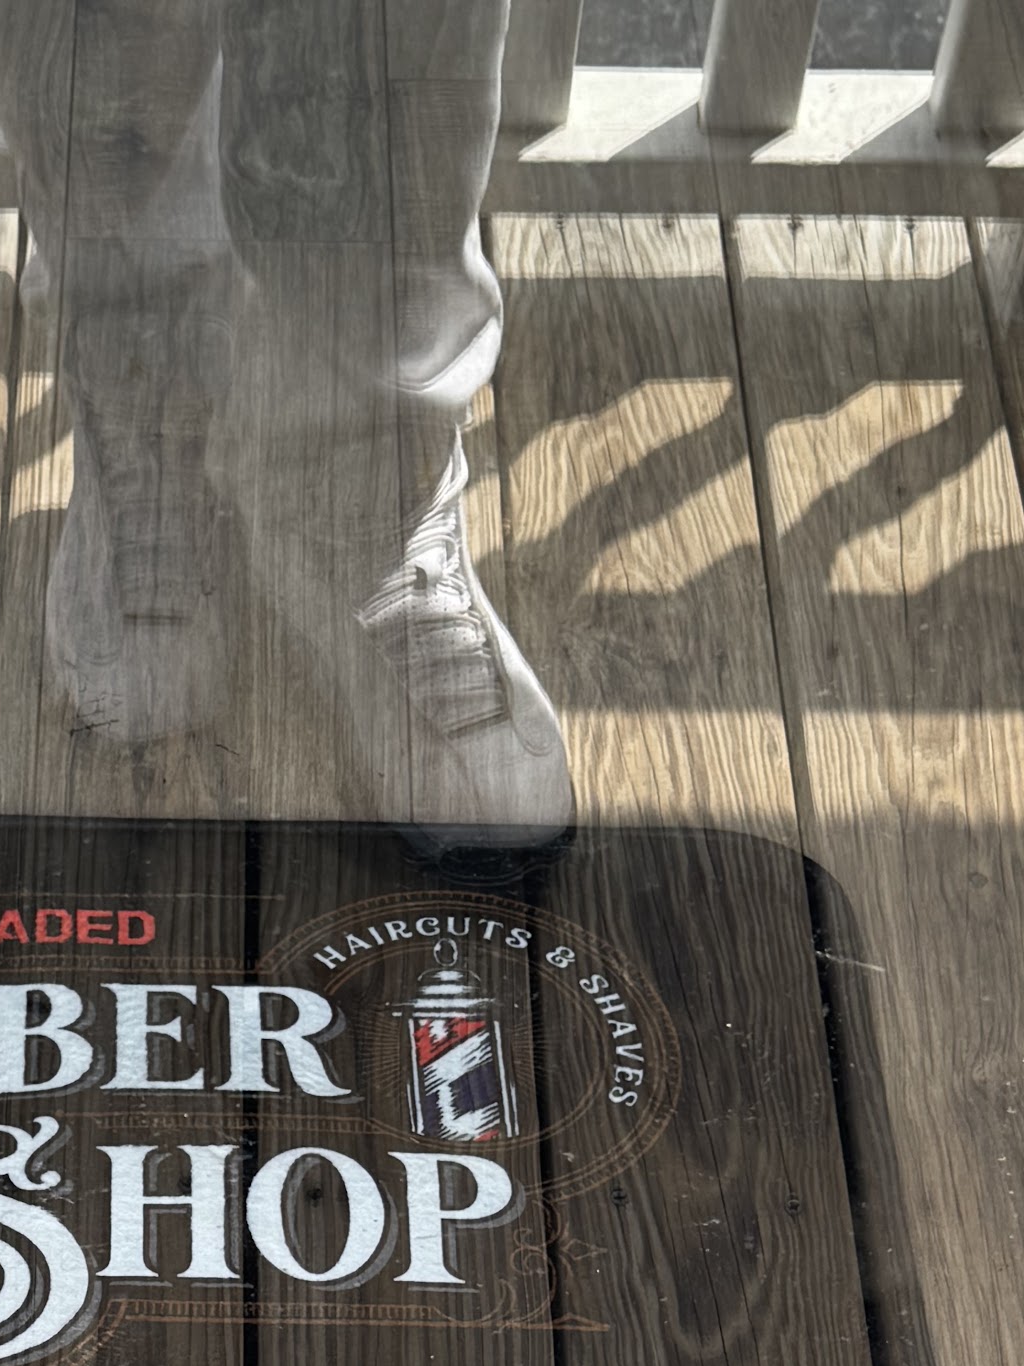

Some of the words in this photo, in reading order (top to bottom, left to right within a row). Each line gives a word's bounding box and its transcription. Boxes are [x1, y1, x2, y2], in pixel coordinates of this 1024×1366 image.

[312, 916, 533, 970] HAIRCUTS
[545, 945, 576, 969] &
[579, 973, 645, 1108] SHAVES
